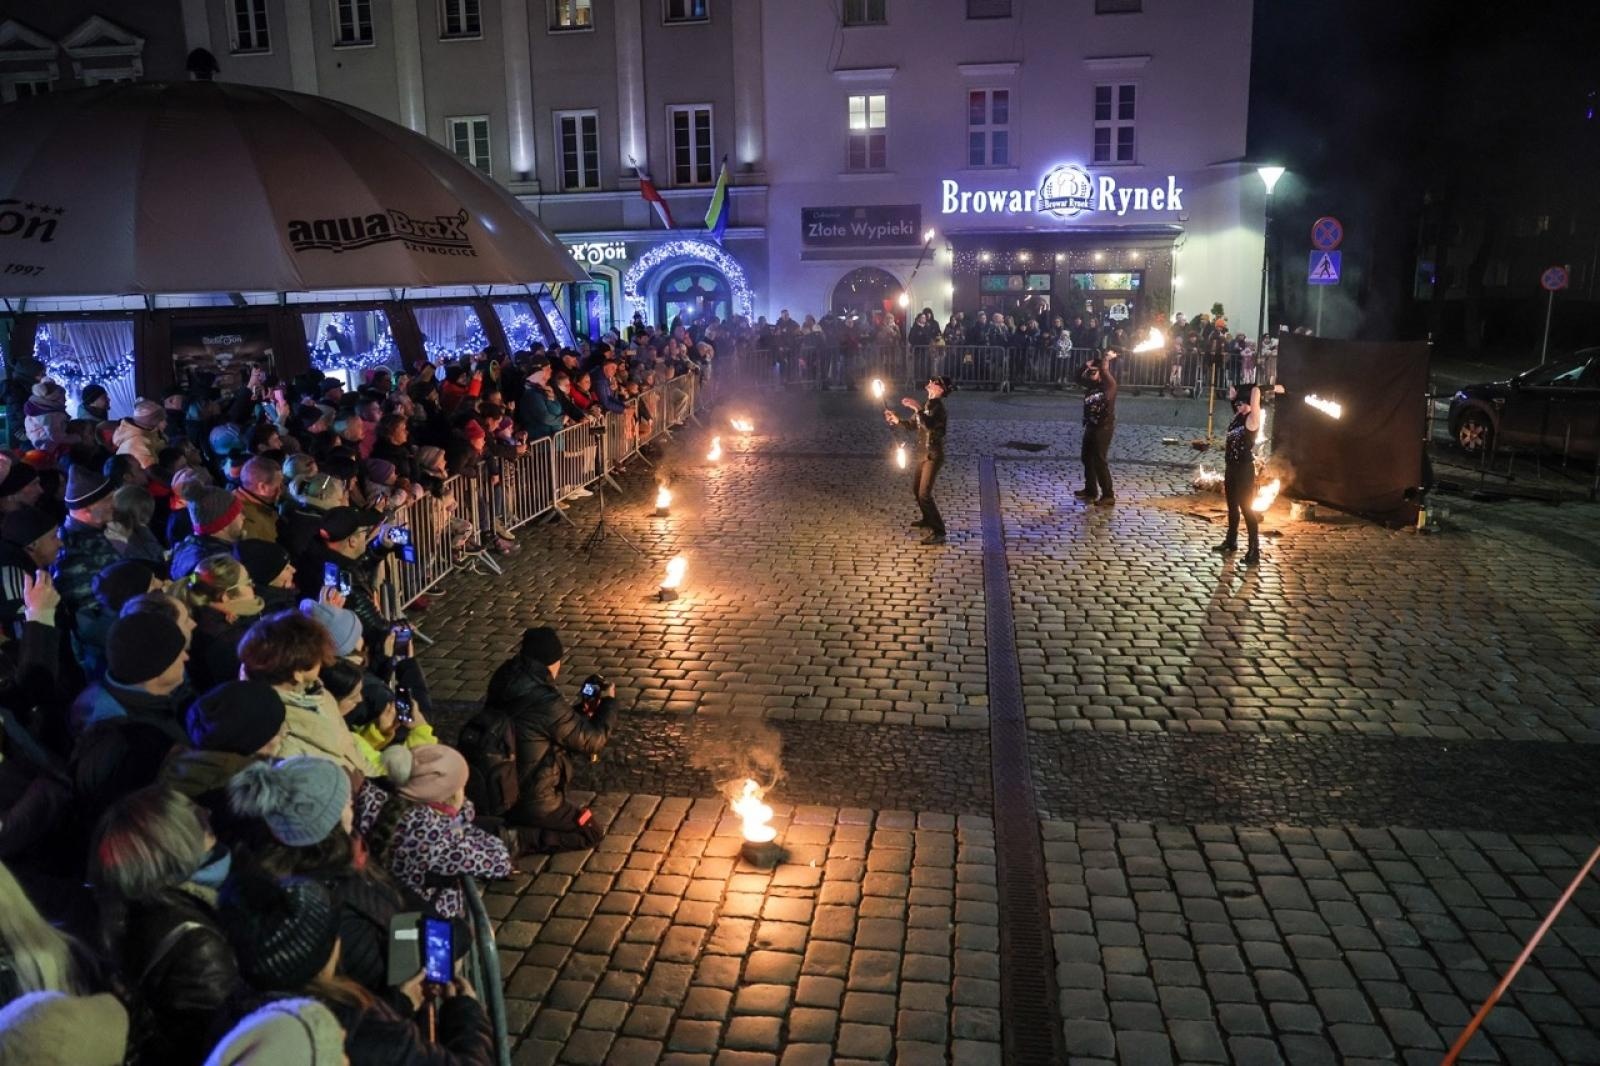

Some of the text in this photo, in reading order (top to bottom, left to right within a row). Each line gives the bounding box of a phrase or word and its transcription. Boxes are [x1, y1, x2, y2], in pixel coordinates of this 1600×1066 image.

[942, 180, 1036, 213] Browar
[1099, 176, 1183, 216] Rynek
[0, 199, 57, 243] on
[809, 219, 913, 239] Złote Wypieki
[4, 263, 45, 276] 1997
